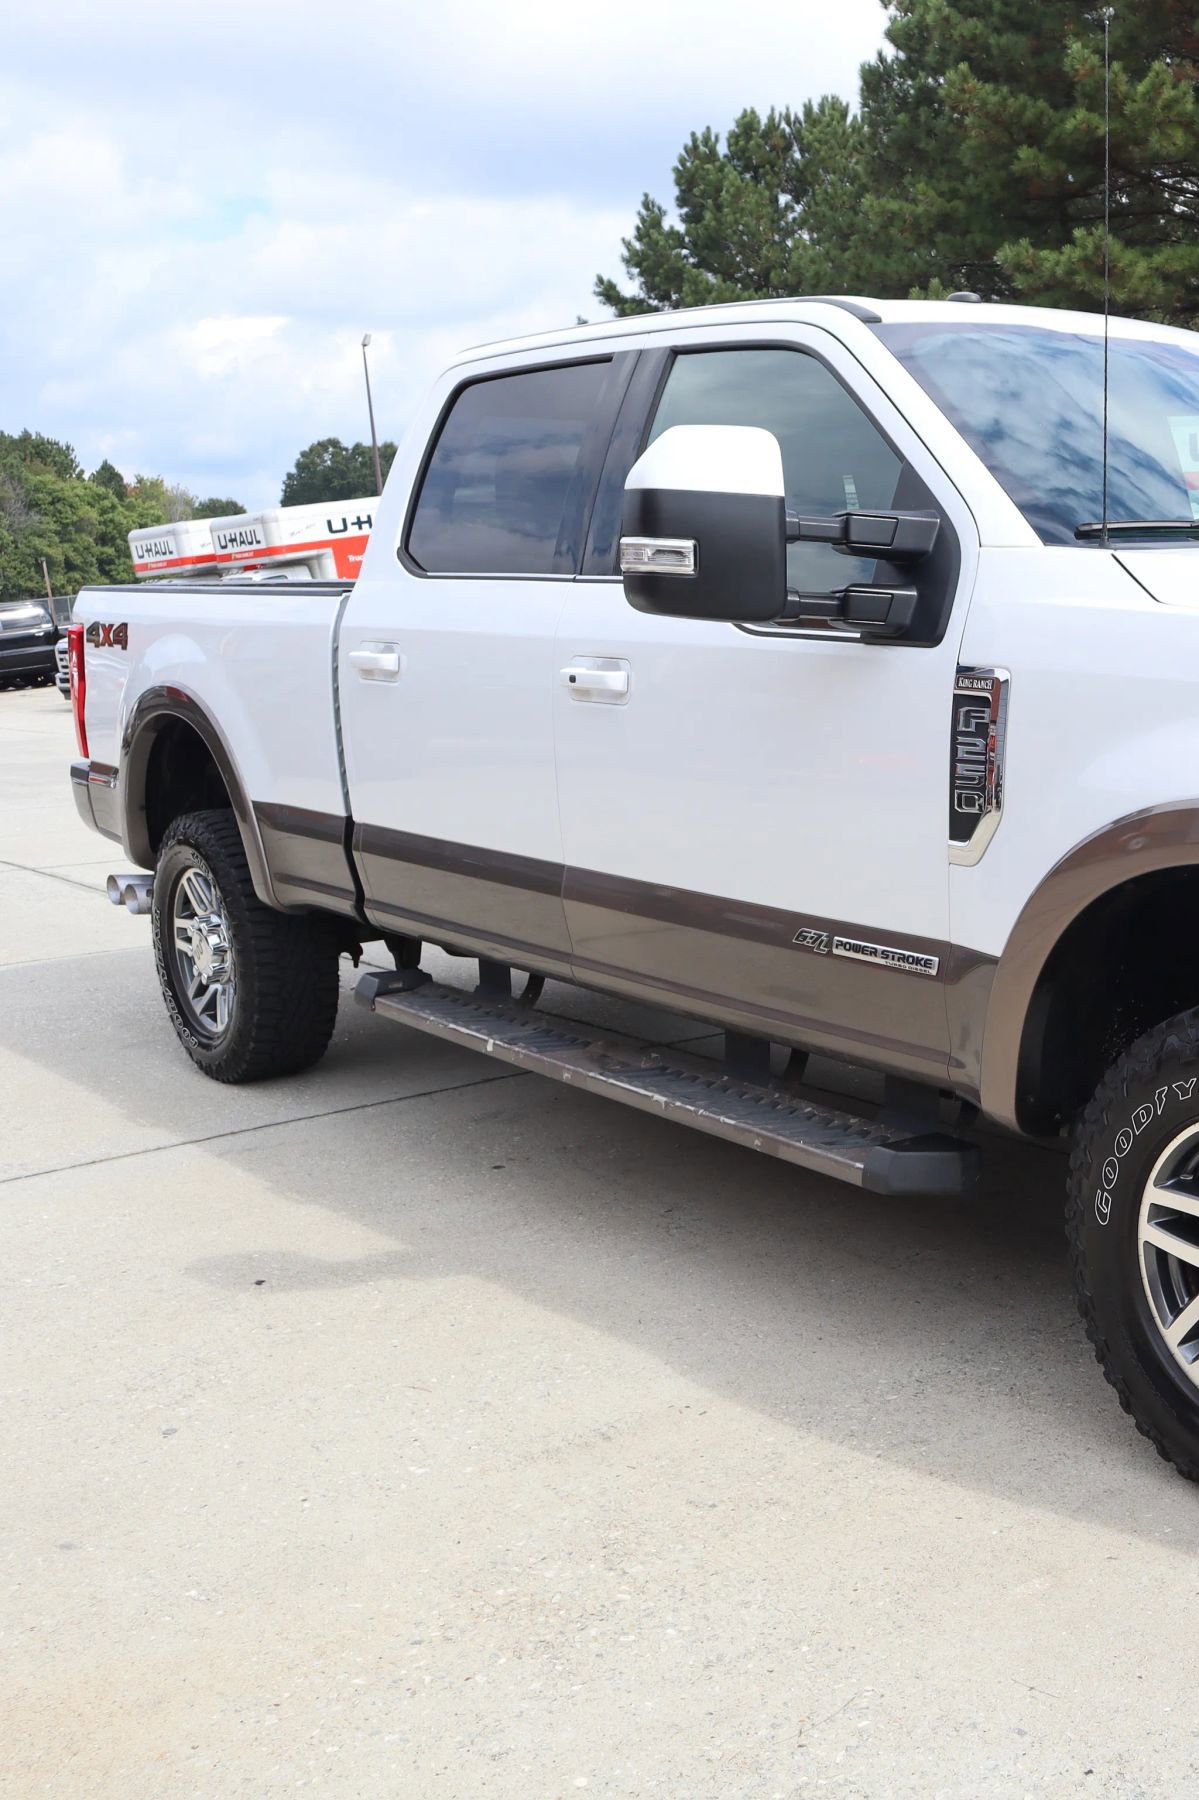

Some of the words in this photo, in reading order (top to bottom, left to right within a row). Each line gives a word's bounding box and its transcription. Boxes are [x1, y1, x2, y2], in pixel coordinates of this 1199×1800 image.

[217, 529, 262, 550] U-HAUL
[135, 540, 174, 560] U-HAUL
[957, 676, 973, 689] KING
[973, 677, 993, 690] RANCH
[792, 927, 830, 954] 6.7L
[835, 939, 878, 958] POWER
[880, 949, 934, 970] STROKE
